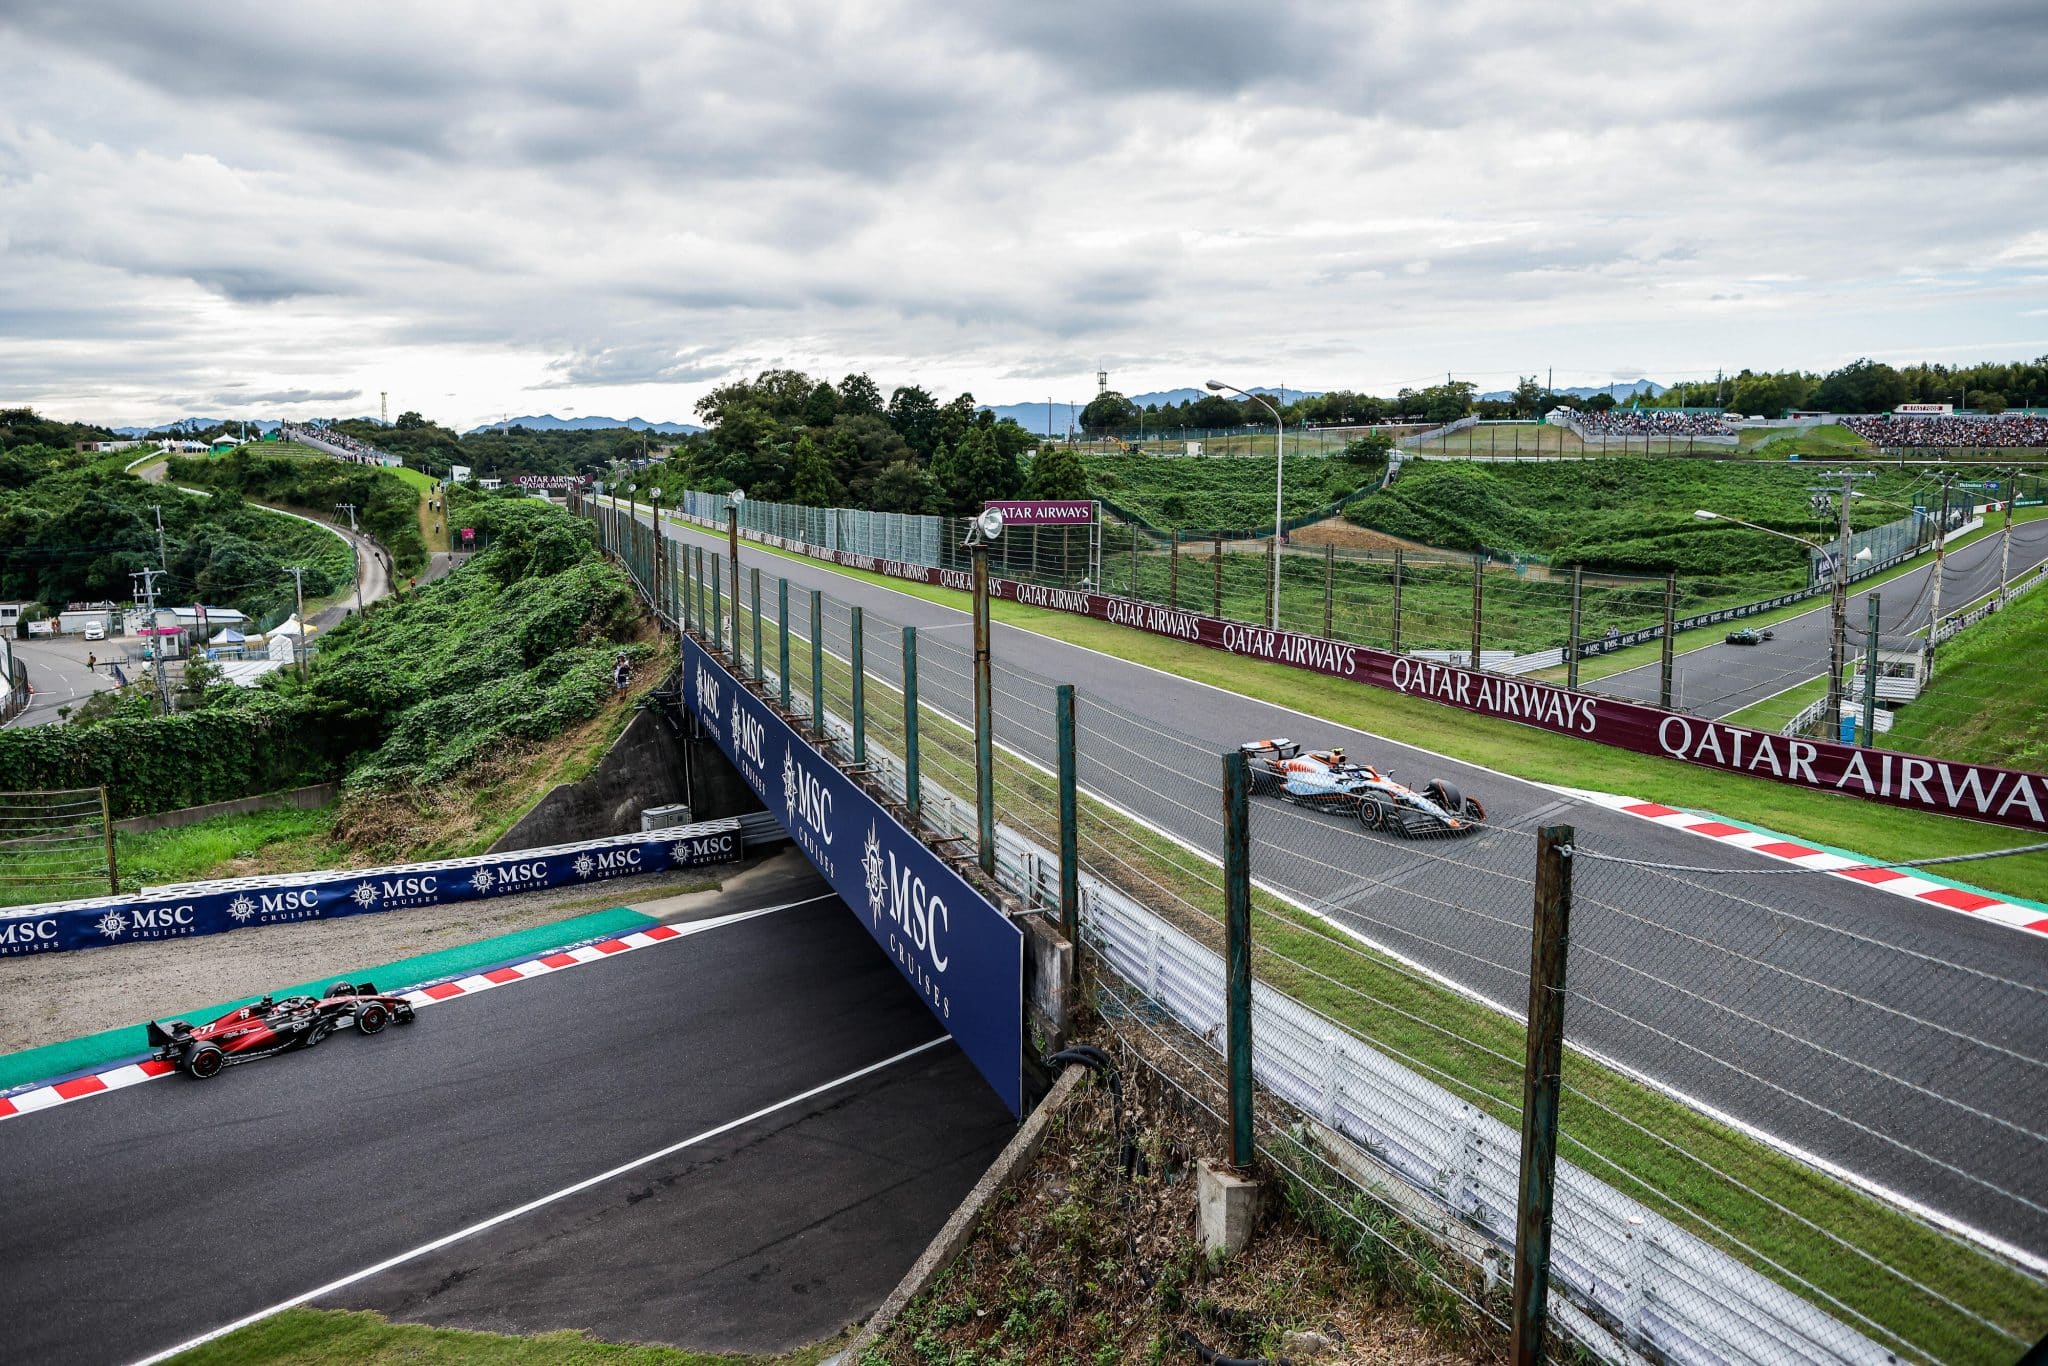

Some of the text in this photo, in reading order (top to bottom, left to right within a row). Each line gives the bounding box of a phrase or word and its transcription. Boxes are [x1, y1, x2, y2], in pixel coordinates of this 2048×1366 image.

[520, 476, 548, 484] QATAR
[1000, 507, 1088, 518] ATAR AIRWAYS
[882, 560, 929, 582] QATAR AIRWAYS
[940, 570, 964, 590] QATAR
[1017, 585, 1089, 614] QATAR AIRWAYS
[1107, 600, 1200, 640] QATAR AIRWAYS
[1223, 624, 1356, 675] QATAR AIRWAYS
[703, 669, 720, 719] MSC
[1392, 659, 1596, 733] QATAR AIRWAYS
[742, 707, 764, 770] MSC
[742, 760, 766, 796] CRUISES
[1658, 717, 2048, 822] QATAR AIRWA
[797, 762, 832, 845] MSC
[692, 837, 732, 856] MSC
[799, 827, 834, 878] CRUISES
[597, 848, 641, 869] MSC
[694, 853, 733, 864] CRUISES
[498, 862, 547, 883] MSC
[598, 866, 642, 877] CRUISES
[382, 876, 437, 898] MSC
[498, 880, 549, 892] CRUISES
[260, 889, 318, 913] MSC
[383, 895, 438, 908] CRUISES
[889, 850, 948, 973] MSC
[132, 906, 194, 929] MSC
[261, 910, 320, 922] CRUISES
[0, 920, 58, 944] MSC
[133, 926, 195, 938] CRUISES
[2, 942, 59, 953] RUISES
[890, 933, 949, 1018] CRUISES
[201, 1023, 216, 1034] 77
